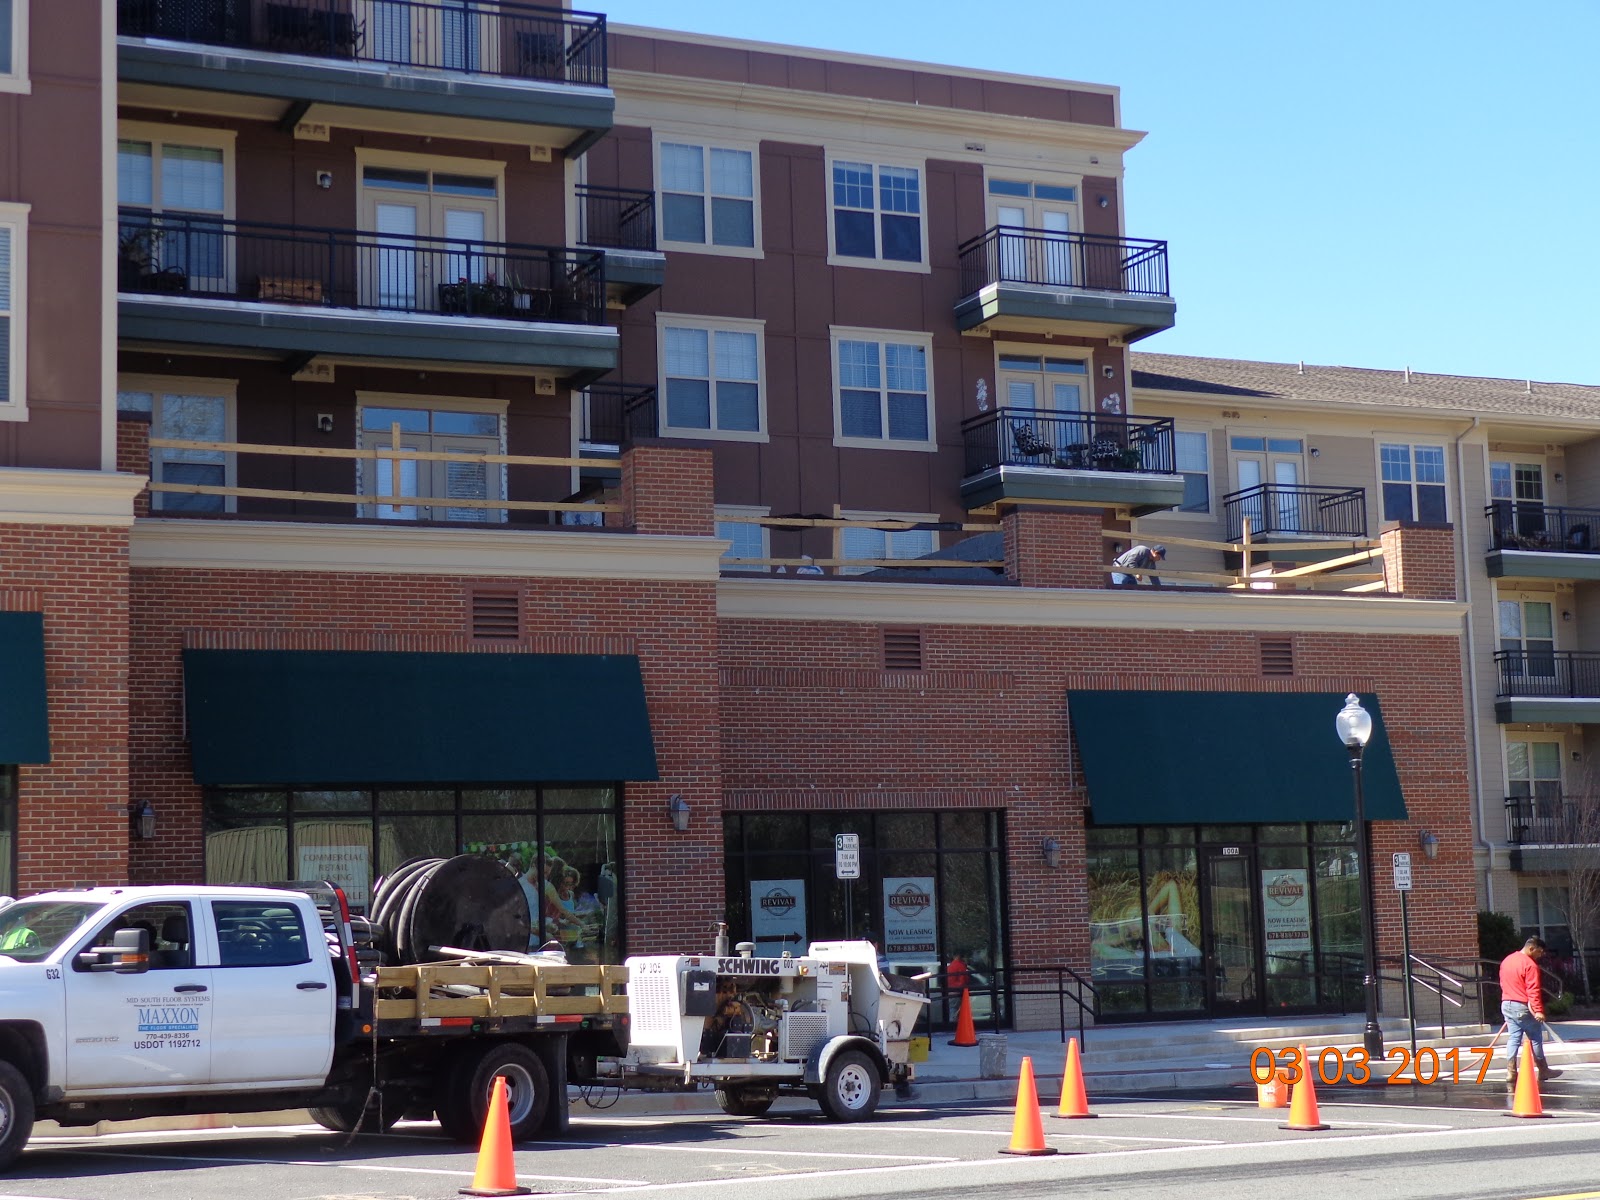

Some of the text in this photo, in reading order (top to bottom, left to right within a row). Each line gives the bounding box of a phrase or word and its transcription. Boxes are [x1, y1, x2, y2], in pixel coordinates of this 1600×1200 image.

[837, 837, 843, 849] 3
[303, 853, 364, 862] COMMERCIAL
[1394, 855, 1399, 866] 3
[318, 863, 350, 872] RETAIL
[316, 873, 352, 882] LEASING
[1269, 887, 1302, 895] REVIVAL
[762, 898, 795, 906] REVIVAL
[890, 896, 929, 905] REVIVAL
[906, 928, 933, 936] LEASING
[717, 958, 780, 975] SCHWING
[184, 995, 211, 1003] SYSTEMS
[138, 1007, 200, 1025] MAXXON
[145, 1032, 190, 1040] 770-439-8336
[134, 1039, 201, 1050] USDOT 1192712
